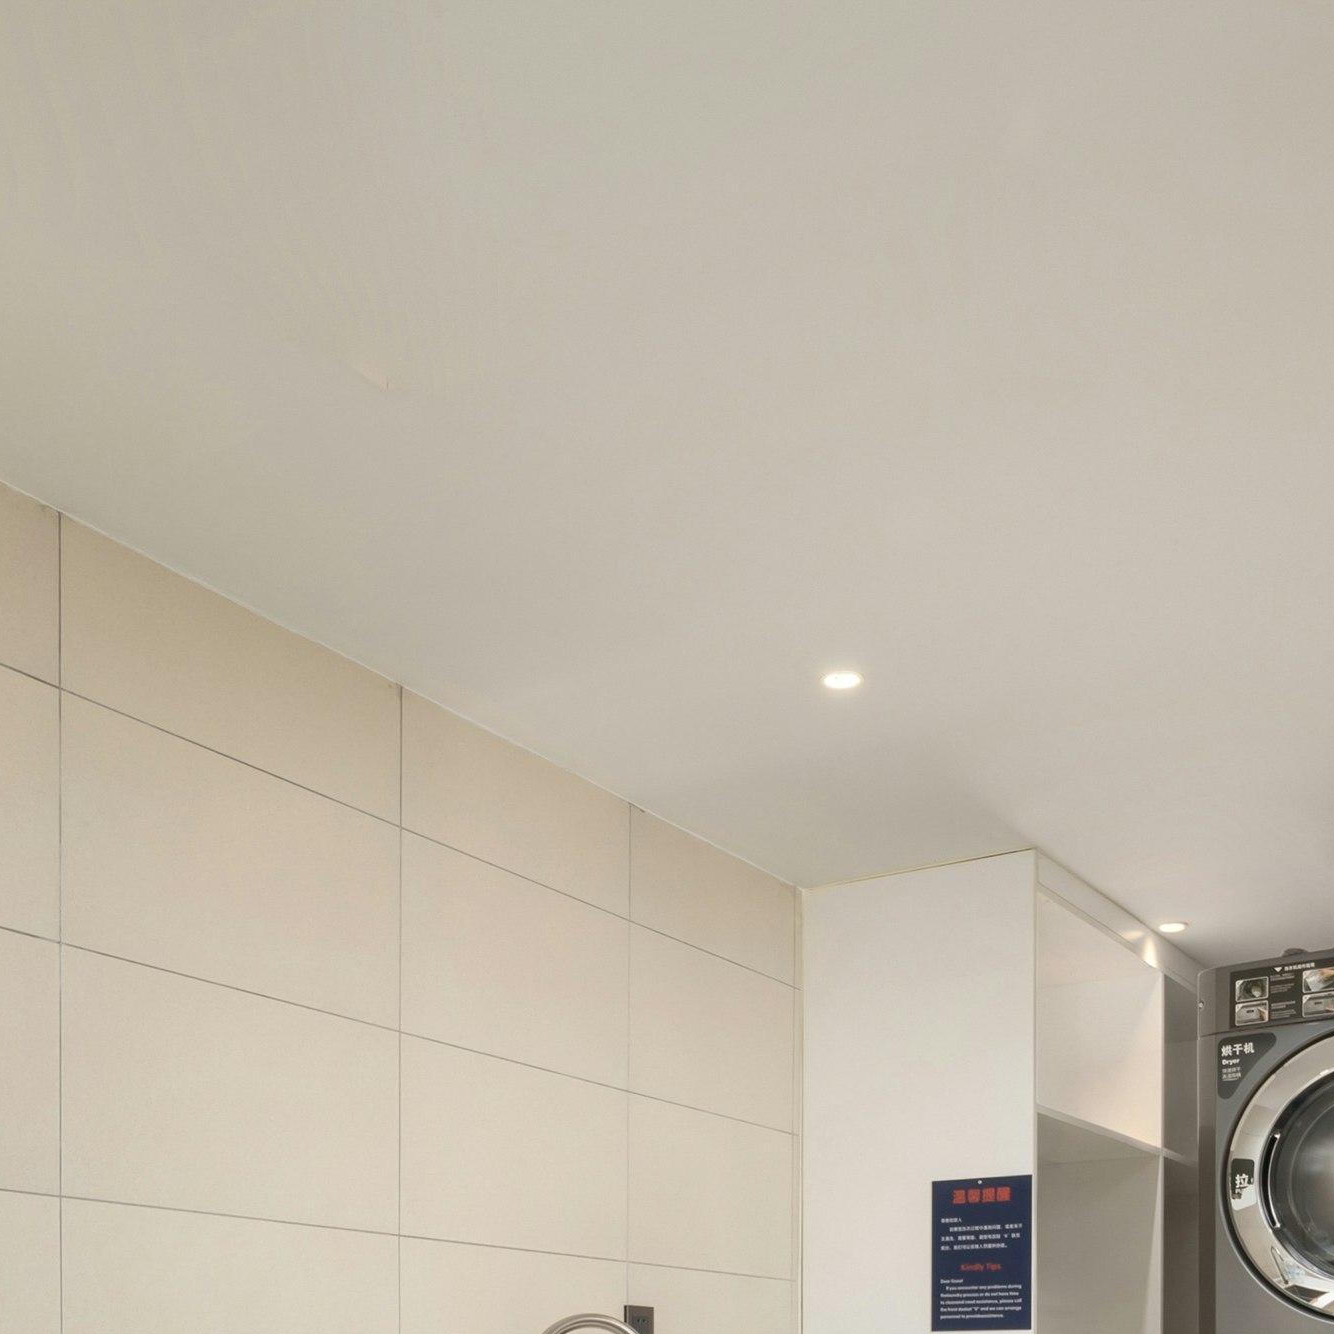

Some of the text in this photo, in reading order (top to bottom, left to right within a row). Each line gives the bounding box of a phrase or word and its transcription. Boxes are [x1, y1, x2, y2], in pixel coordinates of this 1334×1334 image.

[1221, 1042, 1255, 1057] 烘干机
[1222, 1058, 1240, 1066] Dryer
[1235, 1174, 1249, 1189] 拉
